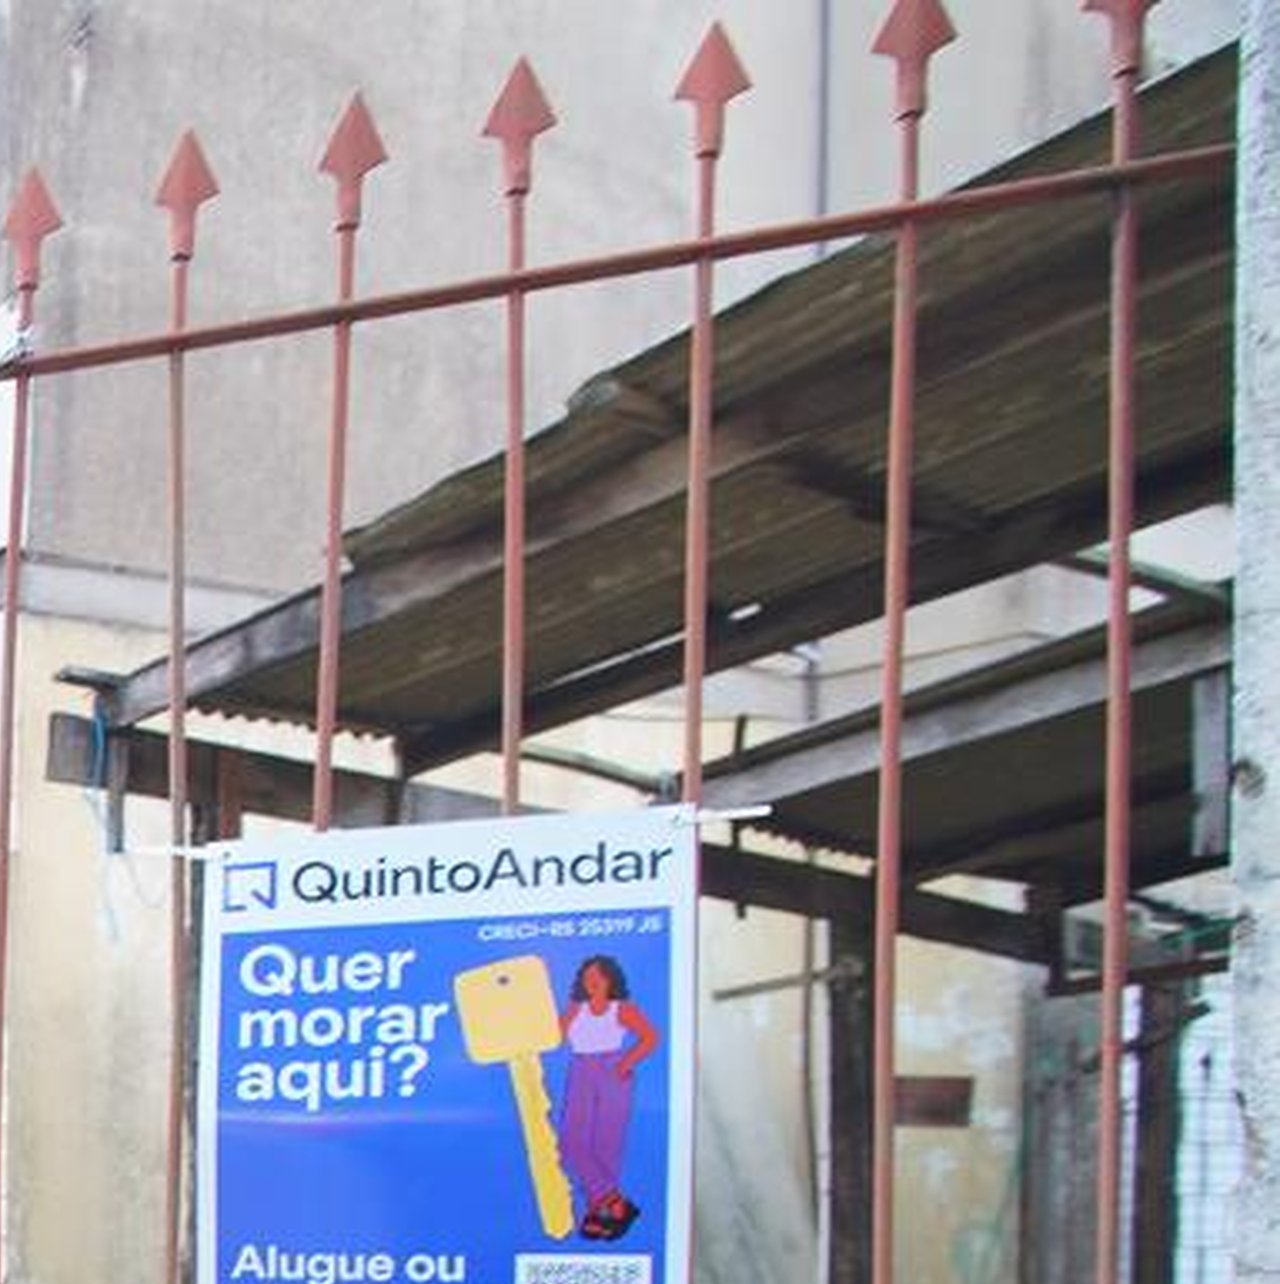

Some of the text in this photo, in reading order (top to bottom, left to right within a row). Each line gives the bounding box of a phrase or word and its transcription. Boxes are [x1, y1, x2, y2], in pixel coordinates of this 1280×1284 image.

[292, 842, 672, 901] QuintoAndar
[241, 944, 416, 995] Quer
[240, 1003, 449, 1048] morar
[237, 1046, 429, 1111] aqui?
[405, 1254, 465, 1282] ou
